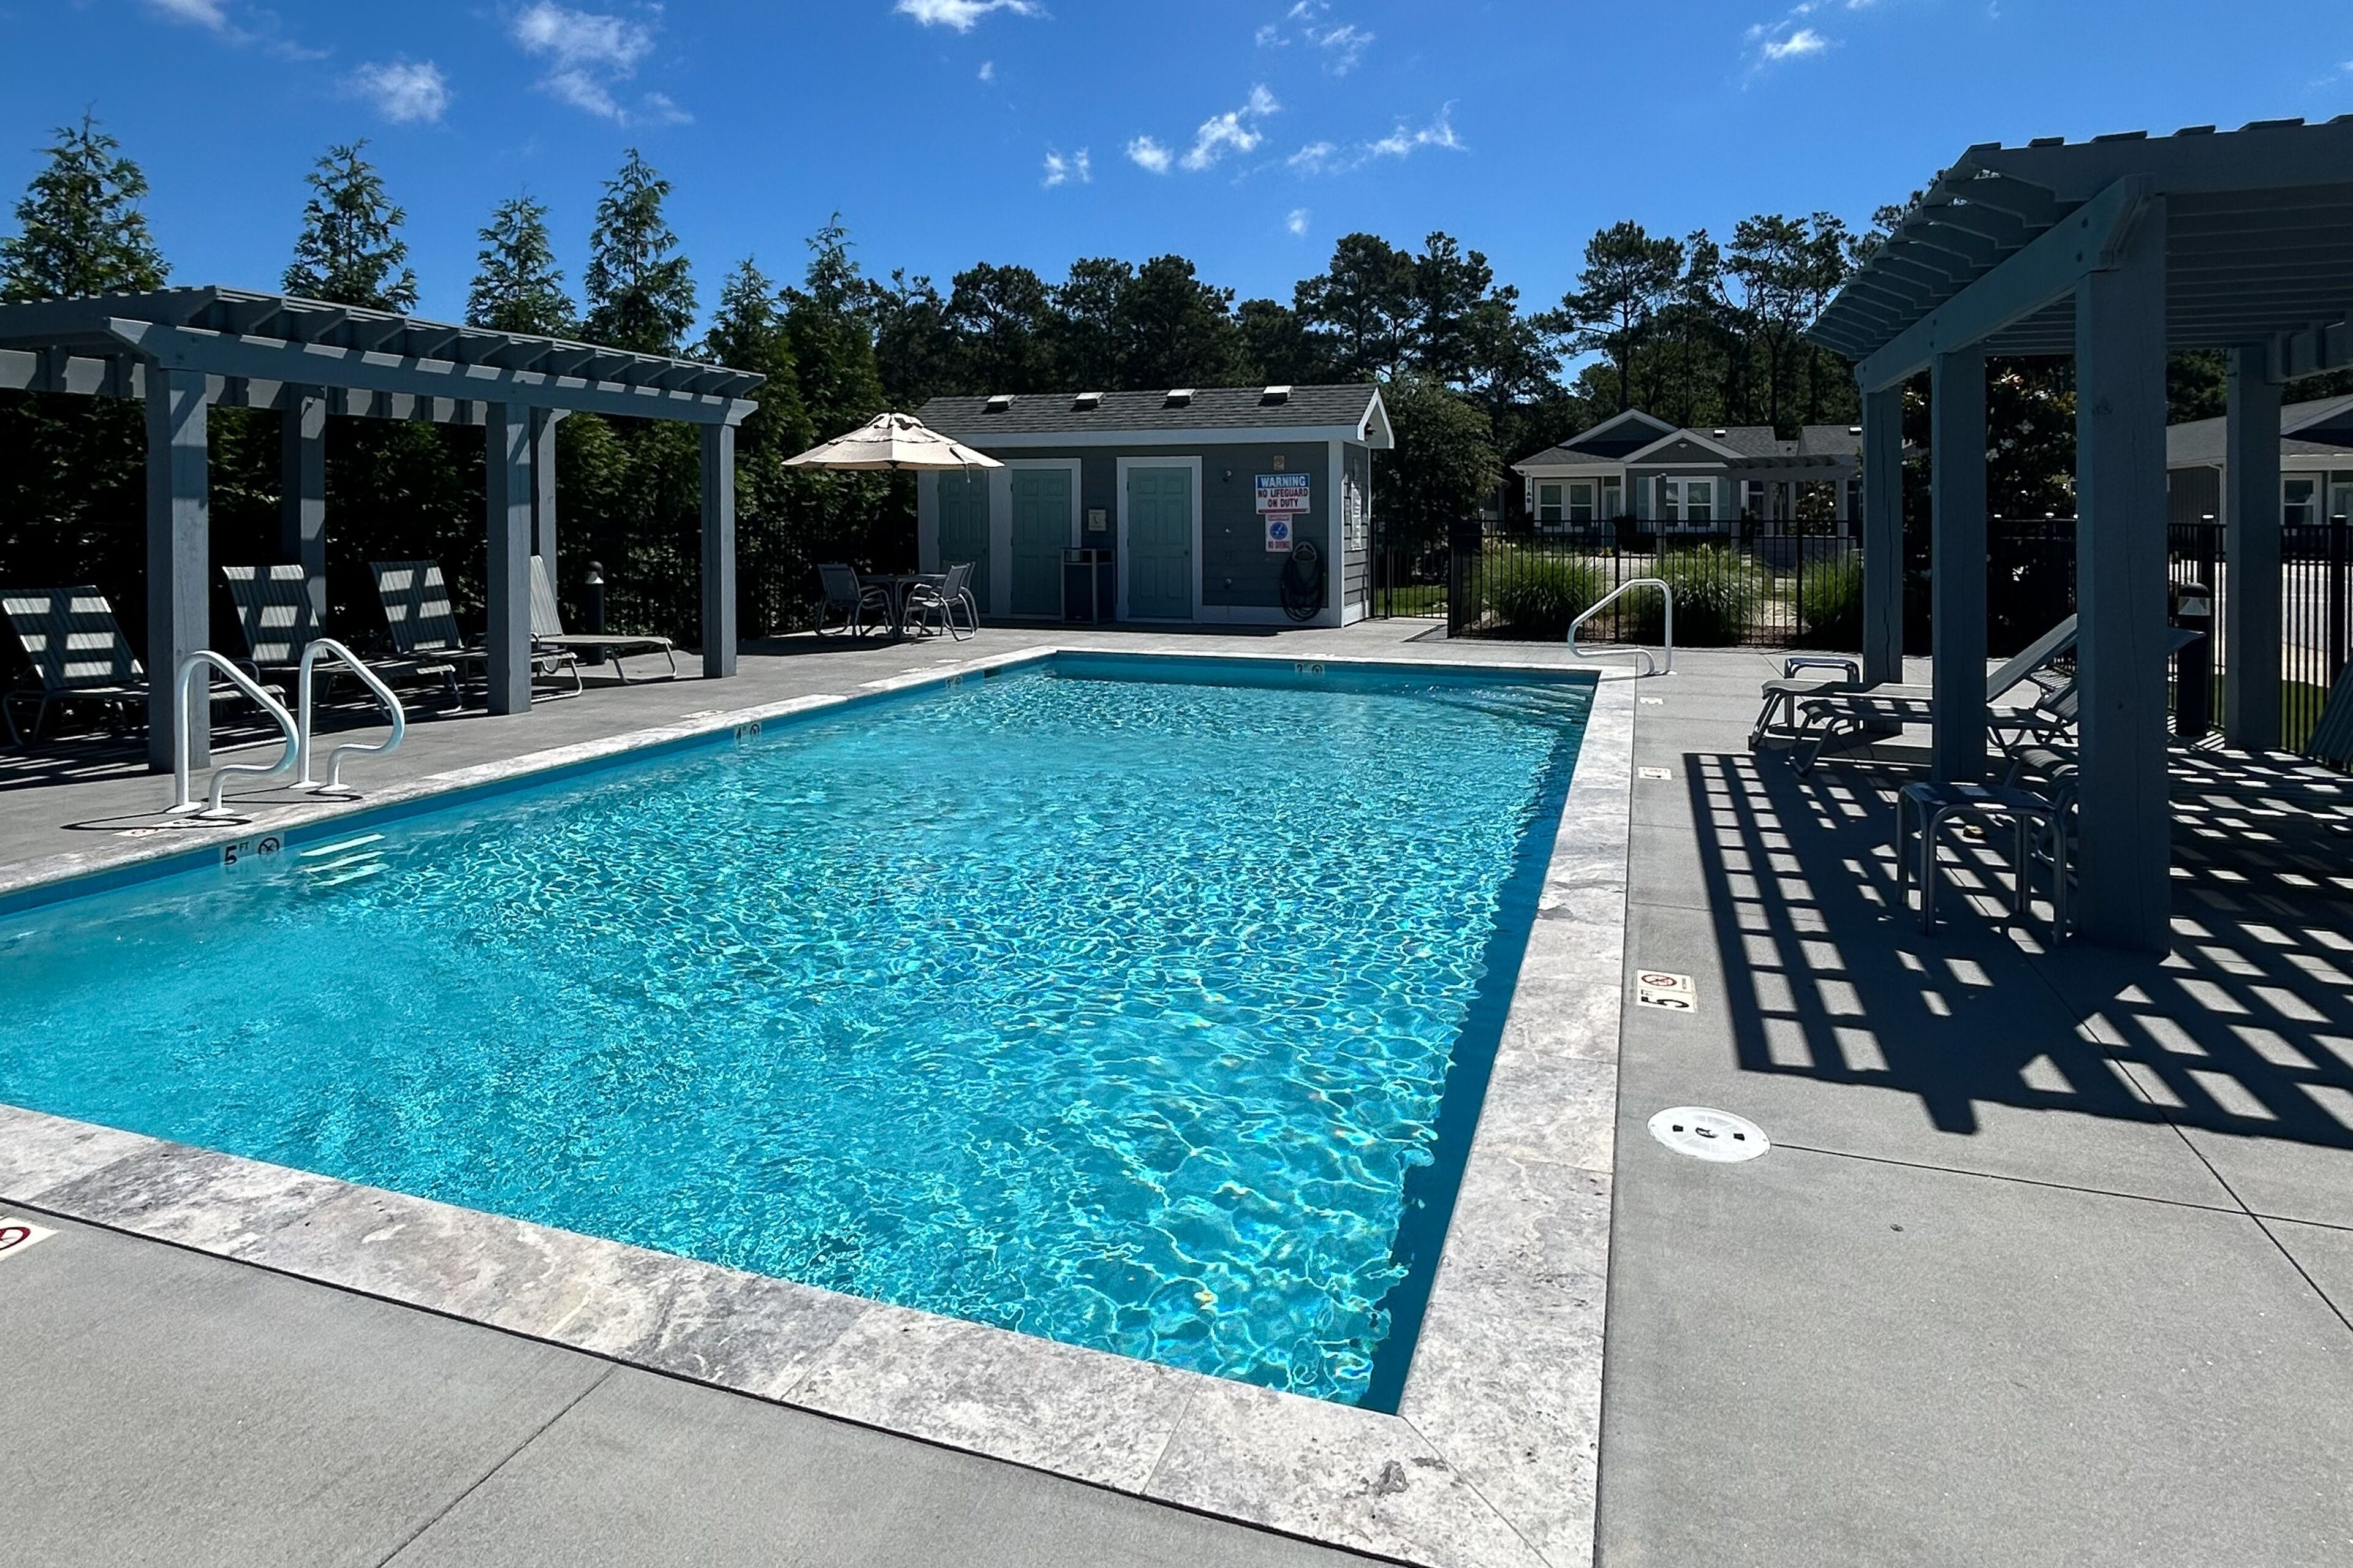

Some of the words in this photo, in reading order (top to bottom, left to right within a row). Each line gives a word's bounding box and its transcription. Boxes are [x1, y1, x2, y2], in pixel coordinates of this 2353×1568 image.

[1260, 475, 1306, 487] WARNING
[1270, 488, 1308, 498] LIFEGUARD
[1268, 499, 1277, 507] ON
[1281, 498, 1298, 507] DUTY
[224, 845, 238, 865] 5
[240, 841, 249, 852] FT
[1641, 996, 1689, 1008] 5
